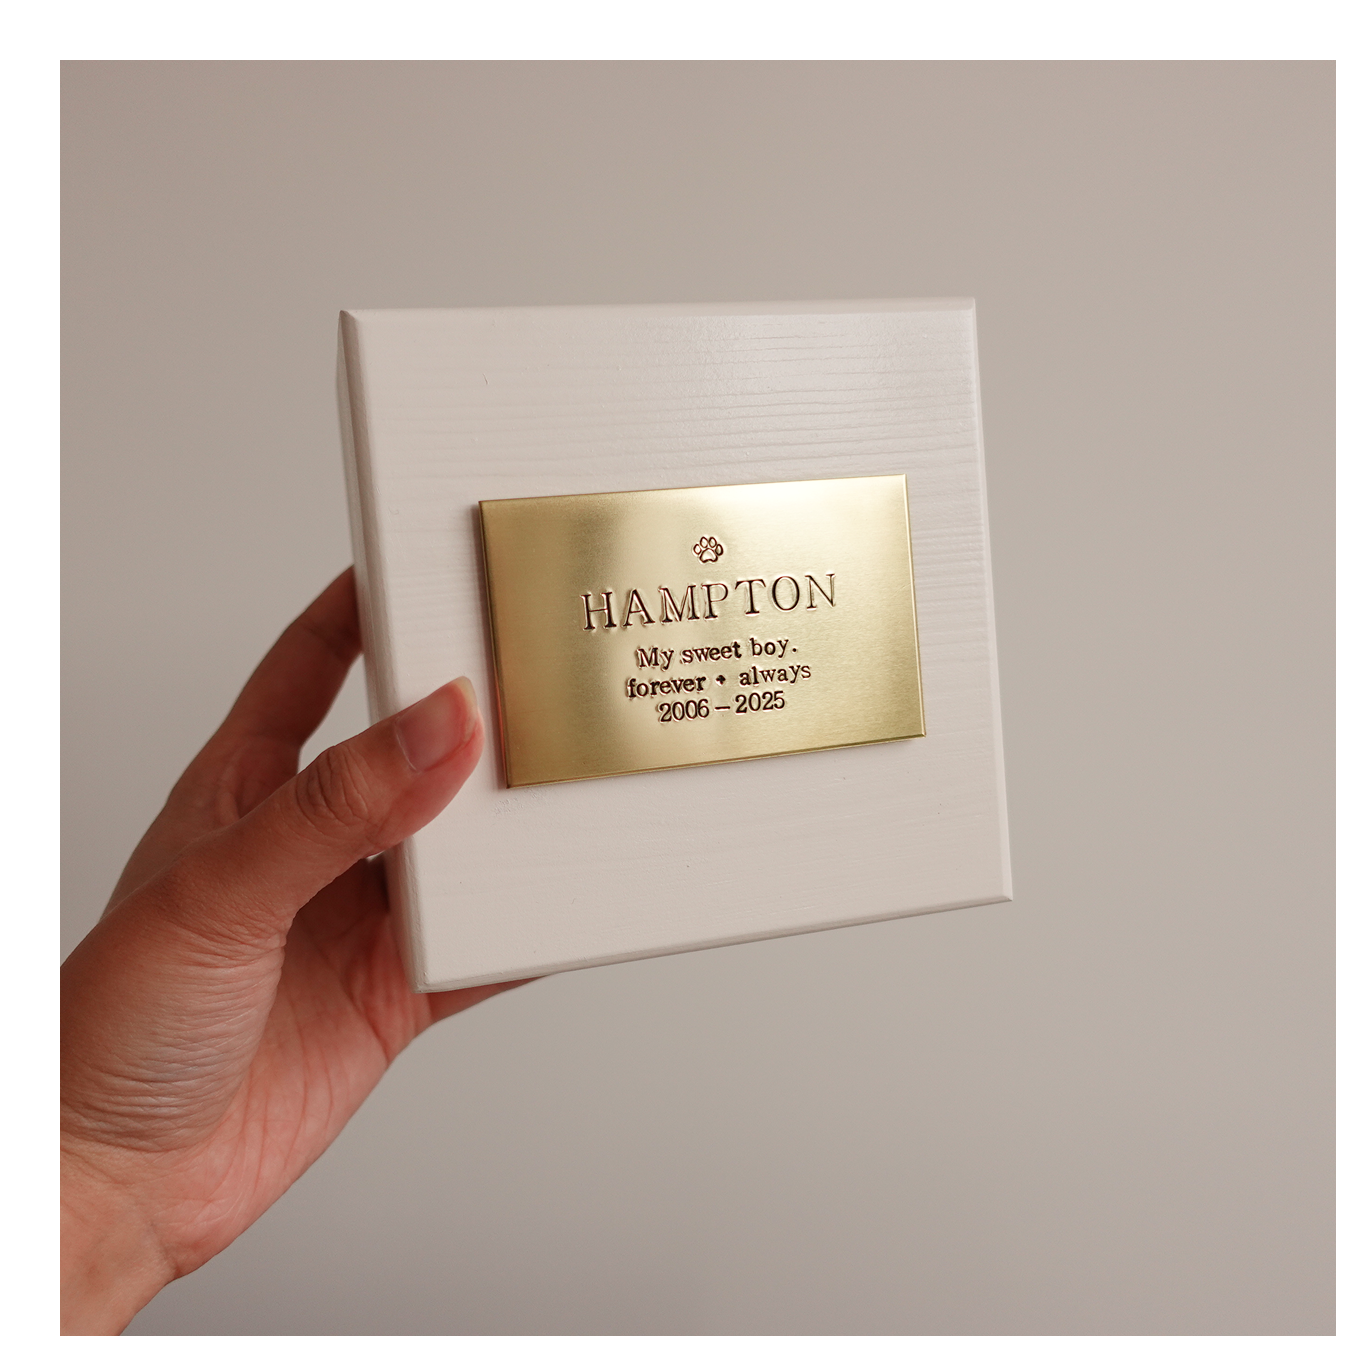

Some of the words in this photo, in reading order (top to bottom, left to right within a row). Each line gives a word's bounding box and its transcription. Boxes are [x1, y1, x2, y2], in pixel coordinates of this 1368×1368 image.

[580, 572, 836, 631] HAMPTON
[636, 645, 674, 671] My
[680, 641, 742, 665] sweet
[750, 637, 797, 658] boy.
[627, 676, 707, 699] forever
[738, 664, 812, 684] always
[658, 698, 710, 723] 2006
[735, 690, 785, 714] 2025
